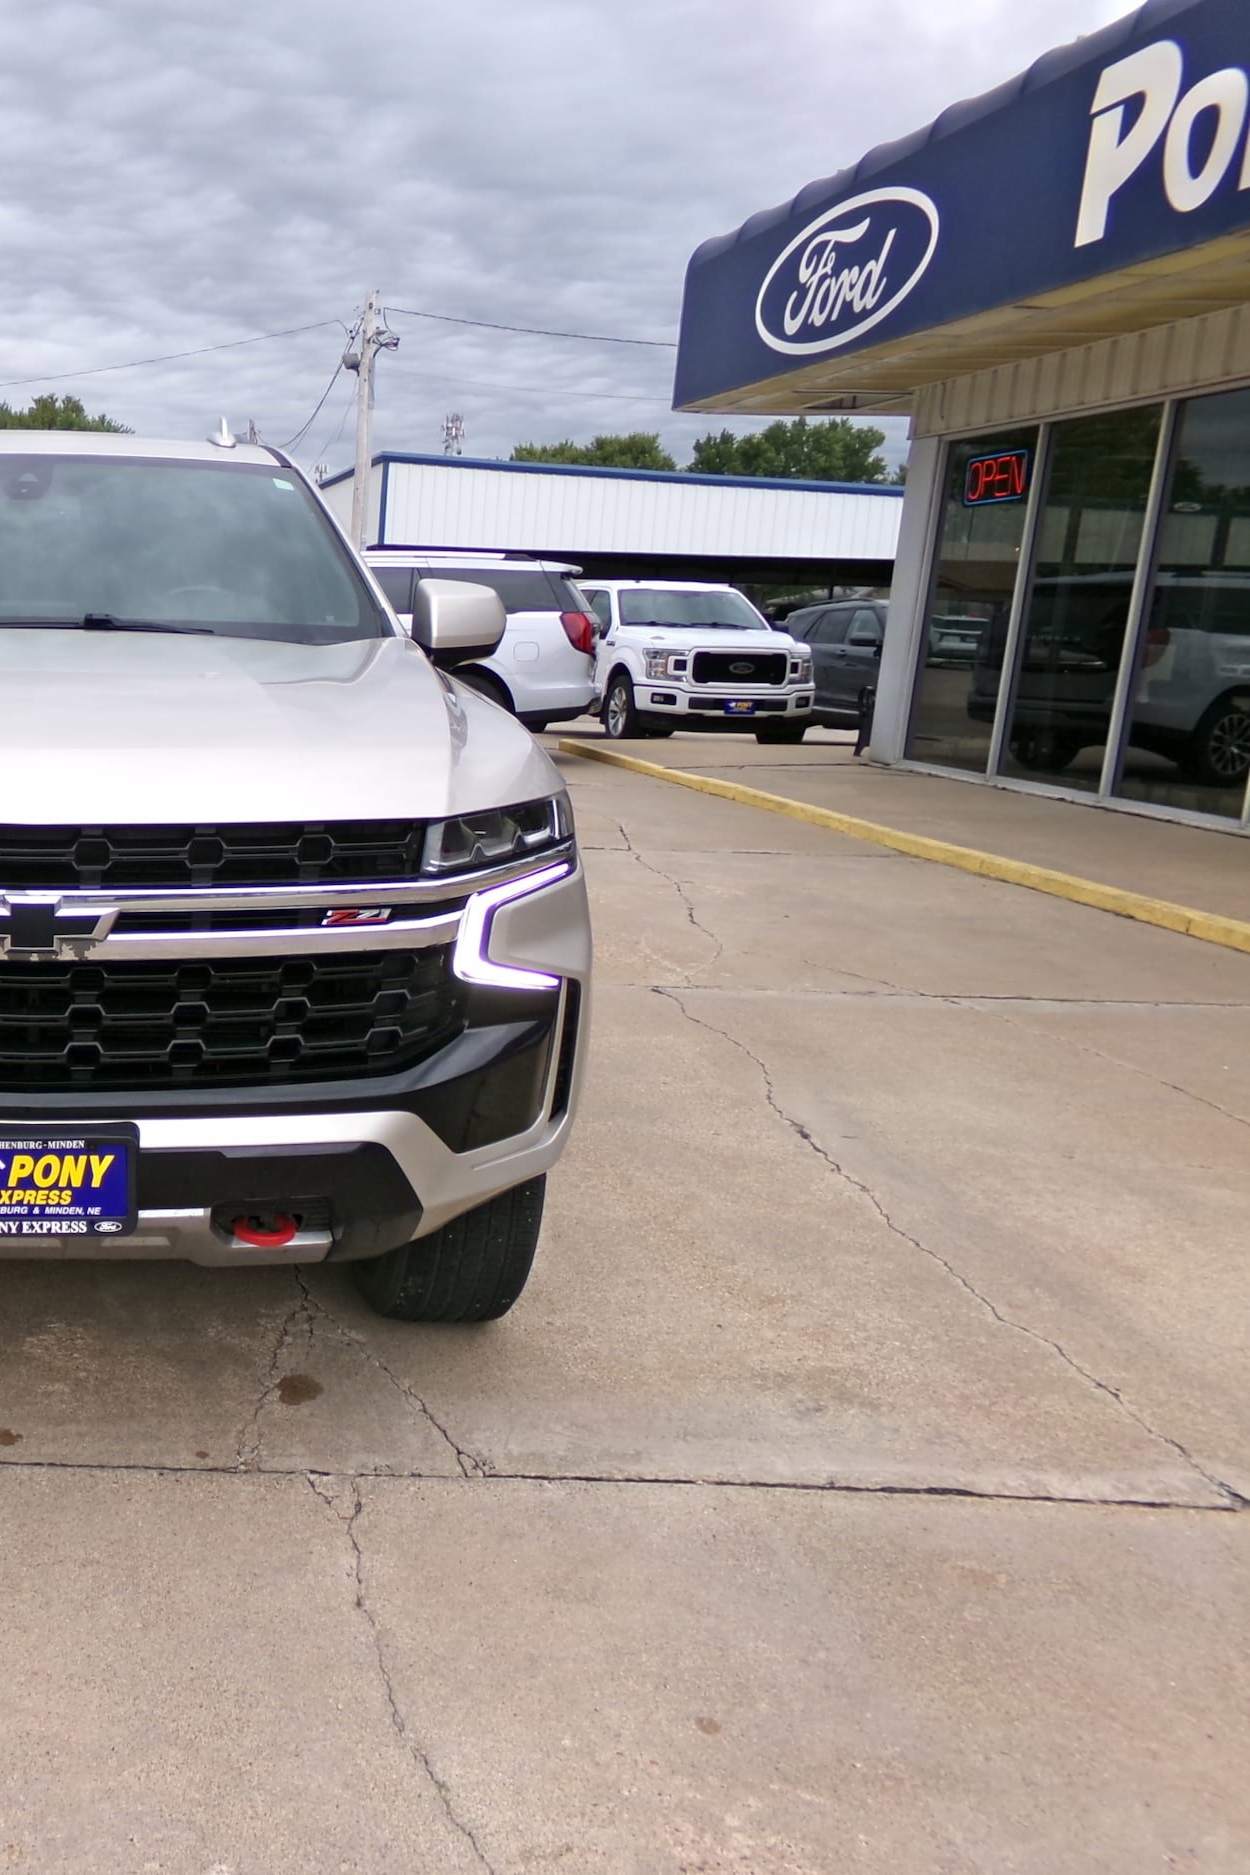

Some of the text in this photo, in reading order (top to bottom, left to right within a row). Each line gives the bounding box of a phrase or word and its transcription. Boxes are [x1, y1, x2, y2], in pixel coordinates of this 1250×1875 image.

[1073, 38, 1250, 249] PO
[783, 216, 898, 337] Ford
[967, 455, 1025, 501] OPEN
[321, 908, 392, 925] Z71
[7, 1154, 115, 1188] PONY
[22, 1220, 88, 1234] EXPRESS
[32, 1206, 40, 1215] &
[44, 1206, 85, 1216] MINDEN,
[87, 1206, 102, 1215] NE
